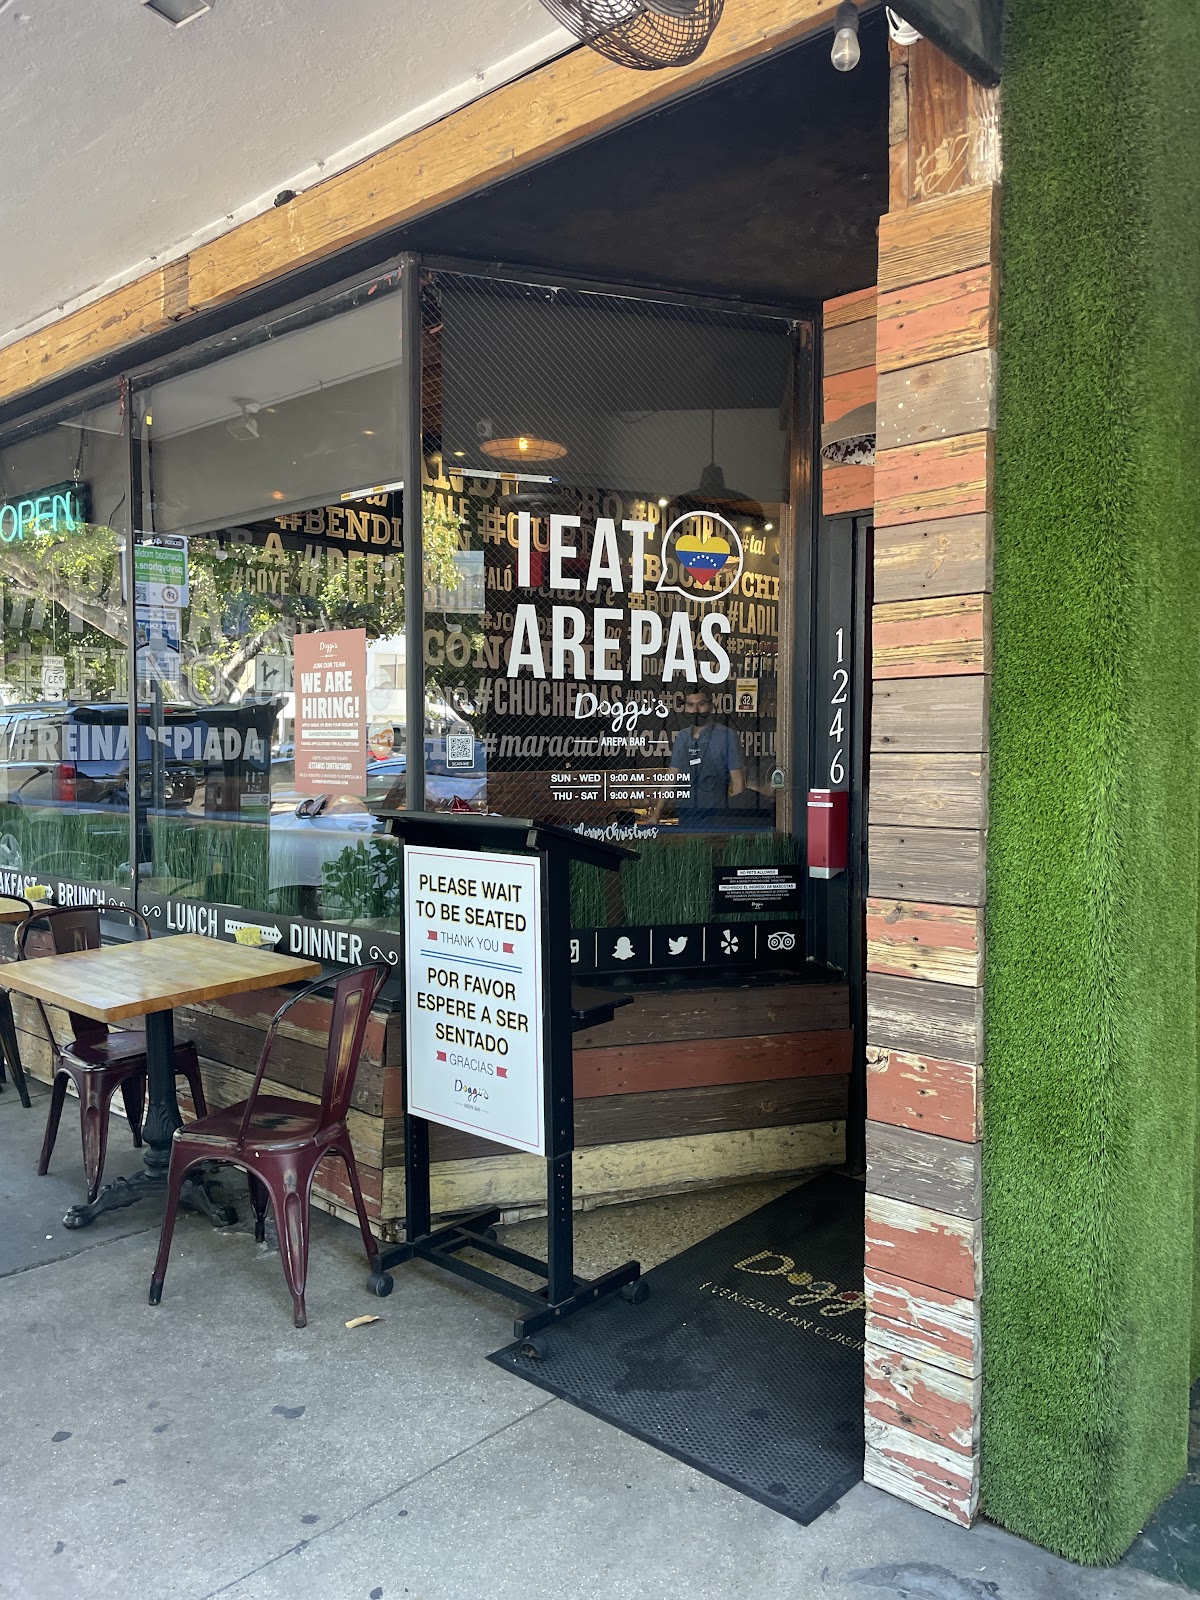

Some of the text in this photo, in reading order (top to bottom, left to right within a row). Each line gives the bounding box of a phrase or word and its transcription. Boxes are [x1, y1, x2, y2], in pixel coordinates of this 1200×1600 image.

[0, 491, 76, 542] OPEN
[518, 511, 655, 594] I EAT
[507, 603, 731, 684] AREPAS
[301, 672, 321, 693] WE
[325, 670, 353, 693] ARE
[302, 696, 360, 719] HIRING!
[575, 691, 669, 733] Doggi's
[742, 695, 751, 705] 32
[829, 627, 849, 784] 1246
[15, 724, 262, 761] #REINAEPIADA
[601, 736, 646, 747] AREPA BAR
[551, 774, 571, 782] SUN
[579, 774, 601, 782] WED
[553, 791, 572, 800] THU
[581, 791, 598, 800] SAT
[610, 791, 628, 799] 9:00
[630, 791, 644, 799] AM
[653, 791, 674, 799] 11:00
[677, 791, 690, 799] PM
[605, 822, 659, 841] Christmas
[420, 874, 522, 903] PLEASE WAIT
[58, 882, 105, 913] BRUNCH
[166, 900, 218, 938] LUNCH
[289, 923, 363, 966] DINNER
[416, 899, 527, 932] TO BE SEATED
[441, 931, 499, 952] THANK YOU
[428, 967, 516, 1001] POR FAVOR
[417, 991, 528, 1033] ESPERE A SER
[436, 1022, 509, 1056] SENTADO
[449, 1053, 494, 1076] GRACIAS
